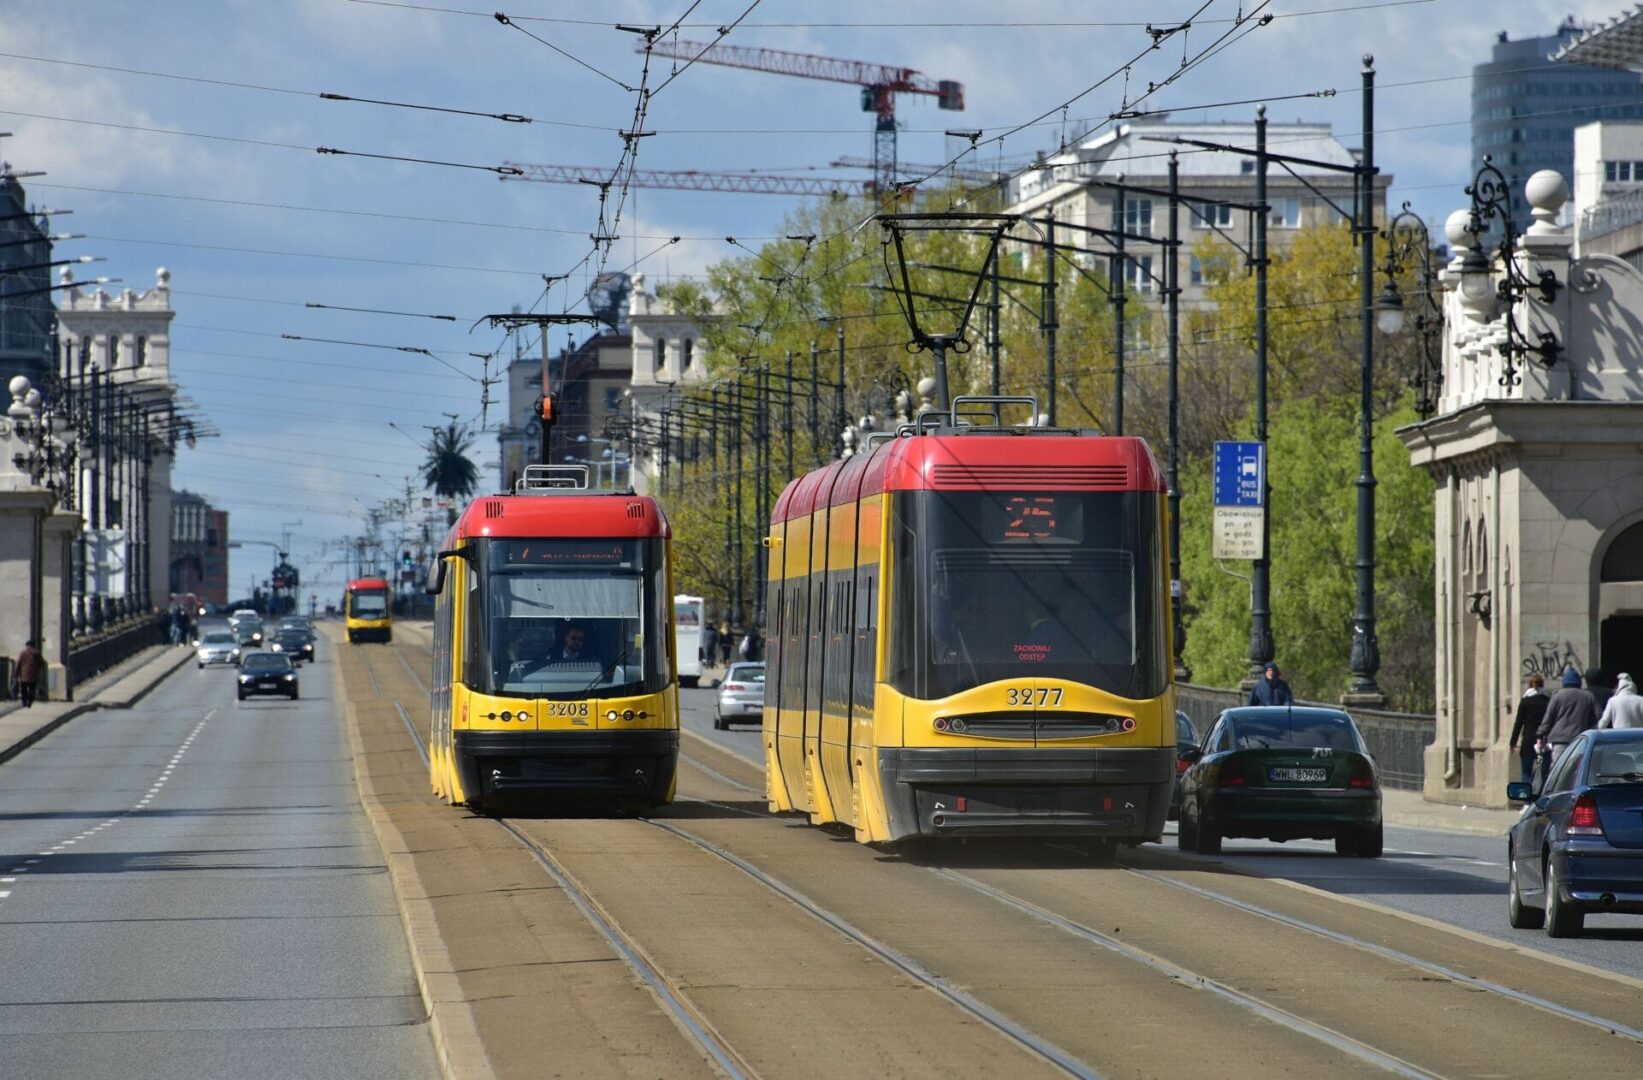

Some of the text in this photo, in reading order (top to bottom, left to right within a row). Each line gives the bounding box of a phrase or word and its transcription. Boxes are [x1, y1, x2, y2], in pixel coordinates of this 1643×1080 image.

[1241, 480, 1256, 488] BUS
[1241, 490, 1258, 498] TAXI
[1005, 497, 1056, 537] 25
[1007, 688, 1063, 706] 3277
[546, 702, 588, 716] 3208
[1296, 768, 1325, 780] 80969
